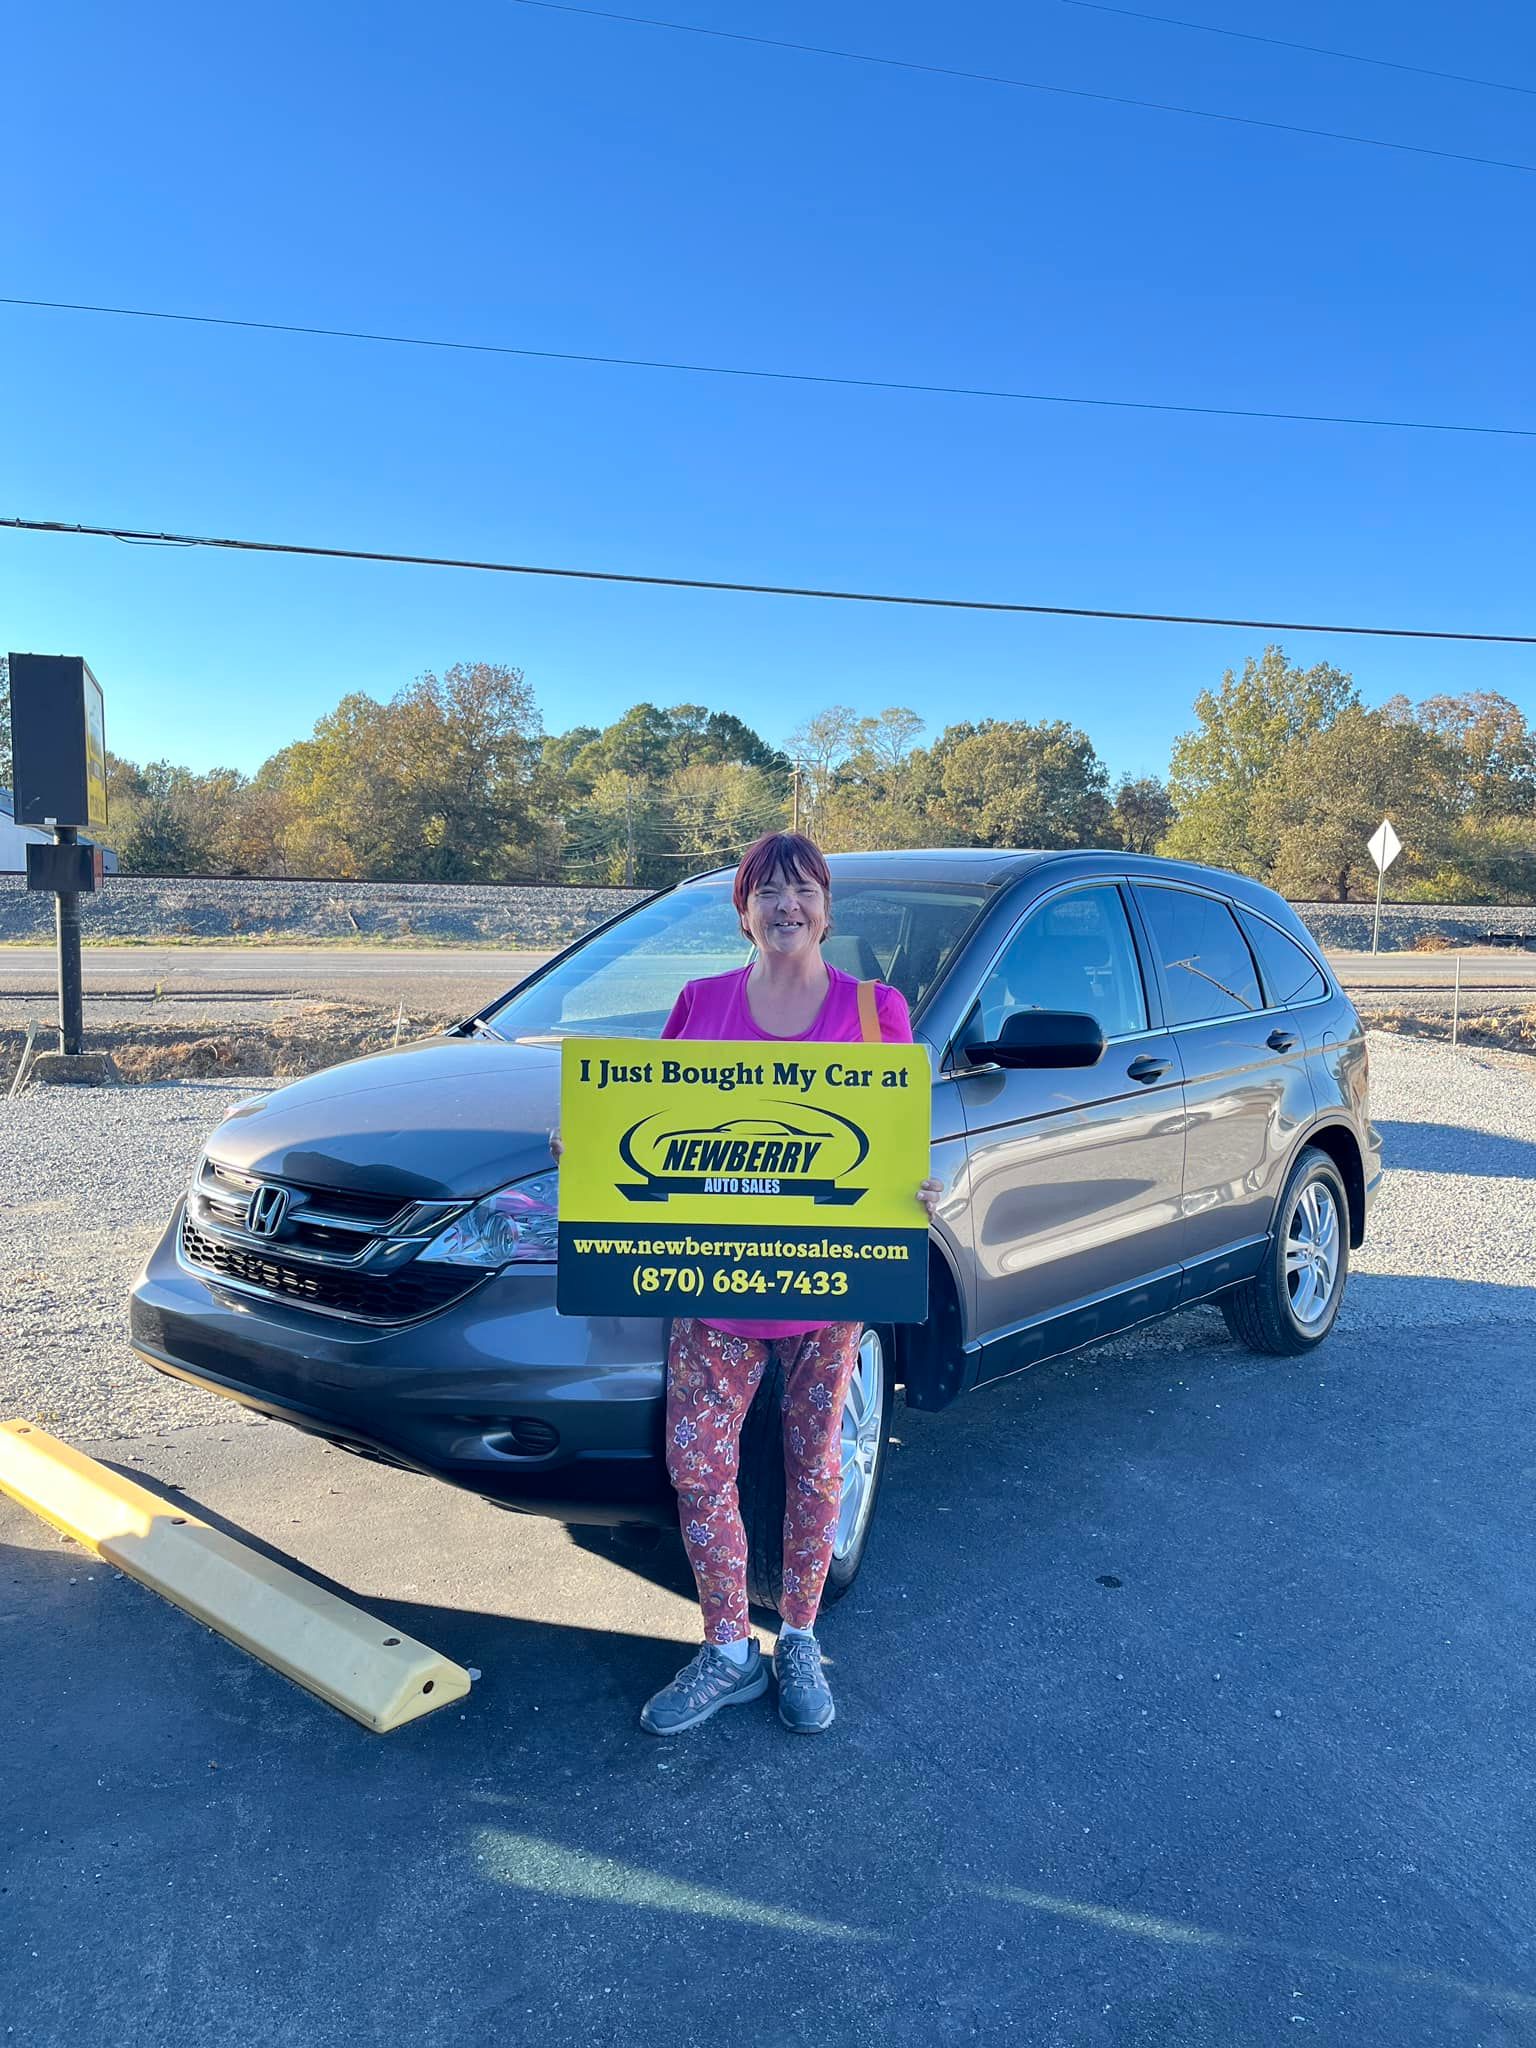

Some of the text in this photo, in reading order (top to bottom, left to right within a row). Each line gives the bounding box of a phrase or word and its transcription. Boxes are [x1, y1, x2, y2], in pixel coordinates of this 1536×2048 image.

[579, 1060, 908, 1092] I Just Bought My Car at
[662, 1140, 822, 1173] NEWBERRY
[704, 1178, 780, 1194] AUTO SALES
[573, 1237, 909, 1261] www.newberryautosales.com
[632, 1266, 849, 1296] (870) 684-7433
